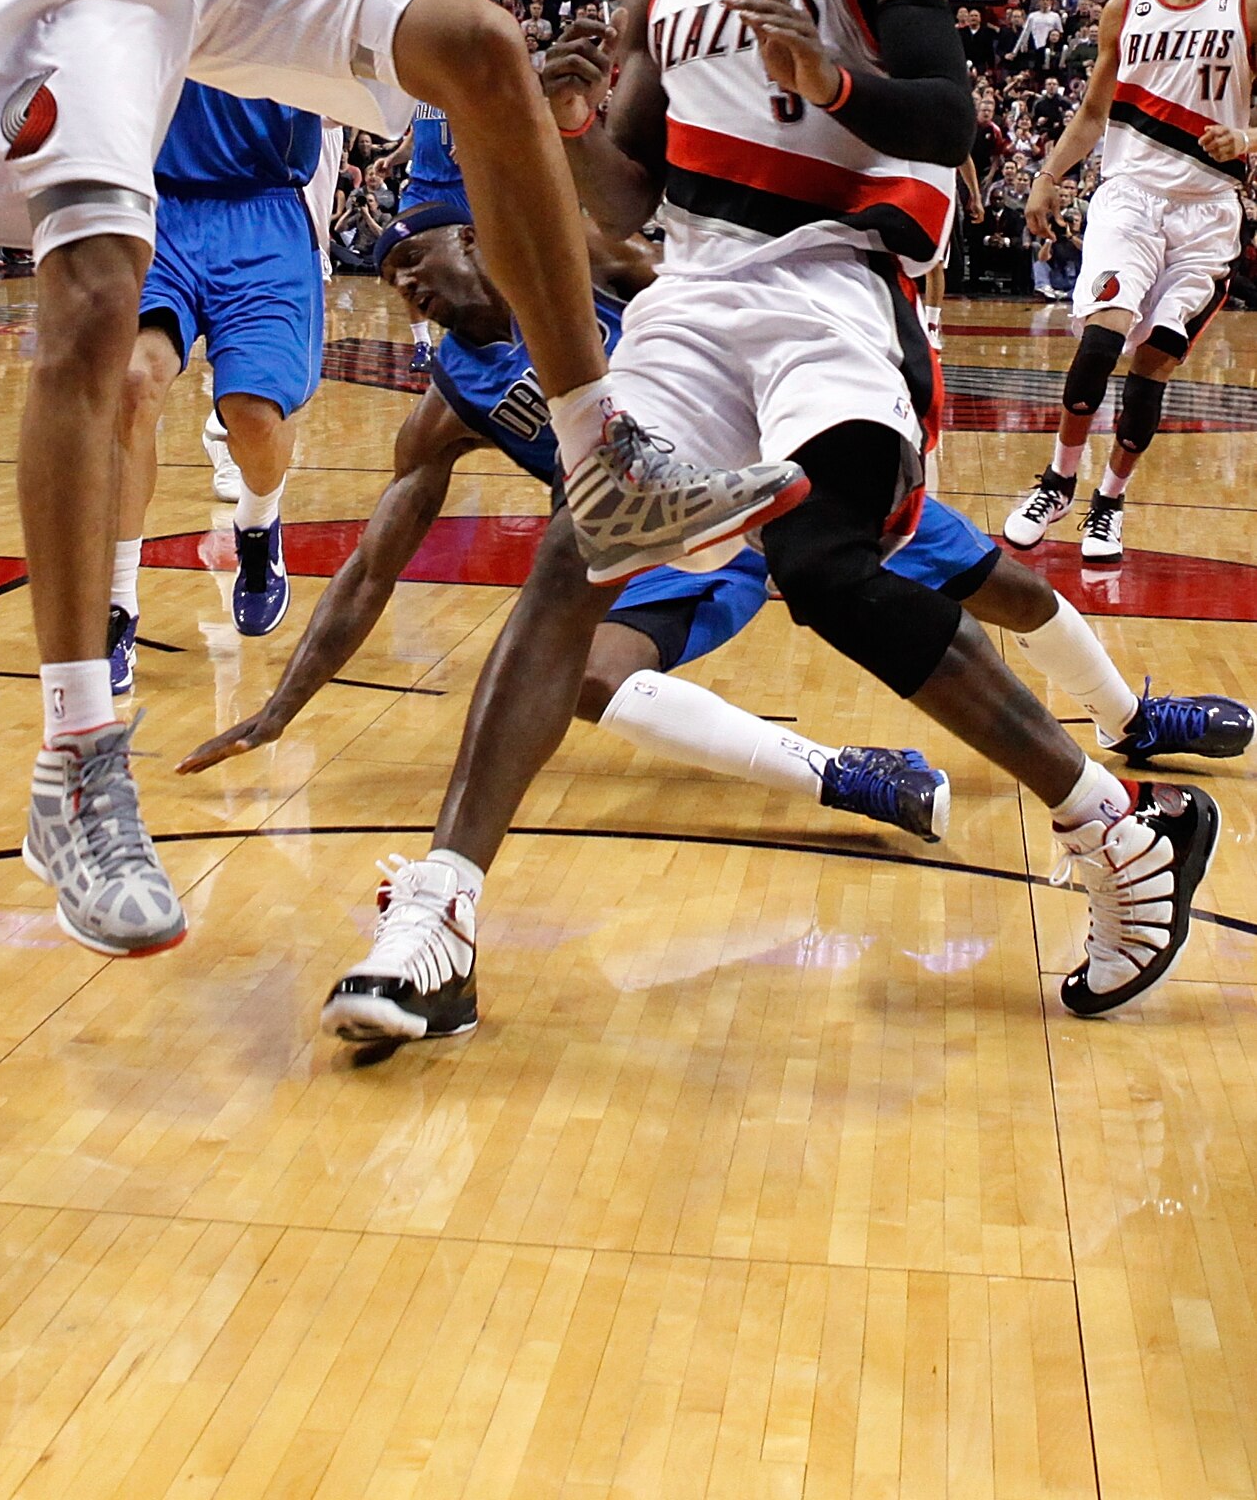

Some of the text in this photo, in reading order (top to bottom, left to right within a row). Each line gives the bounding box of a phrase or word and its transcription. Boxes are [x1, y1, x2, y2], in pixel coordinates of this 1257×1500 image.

[1136, 3, 1150, 14] 20
[1127, 29, 1235, 67] BLAZERS
[1198, 64, 1231, 101] 17
